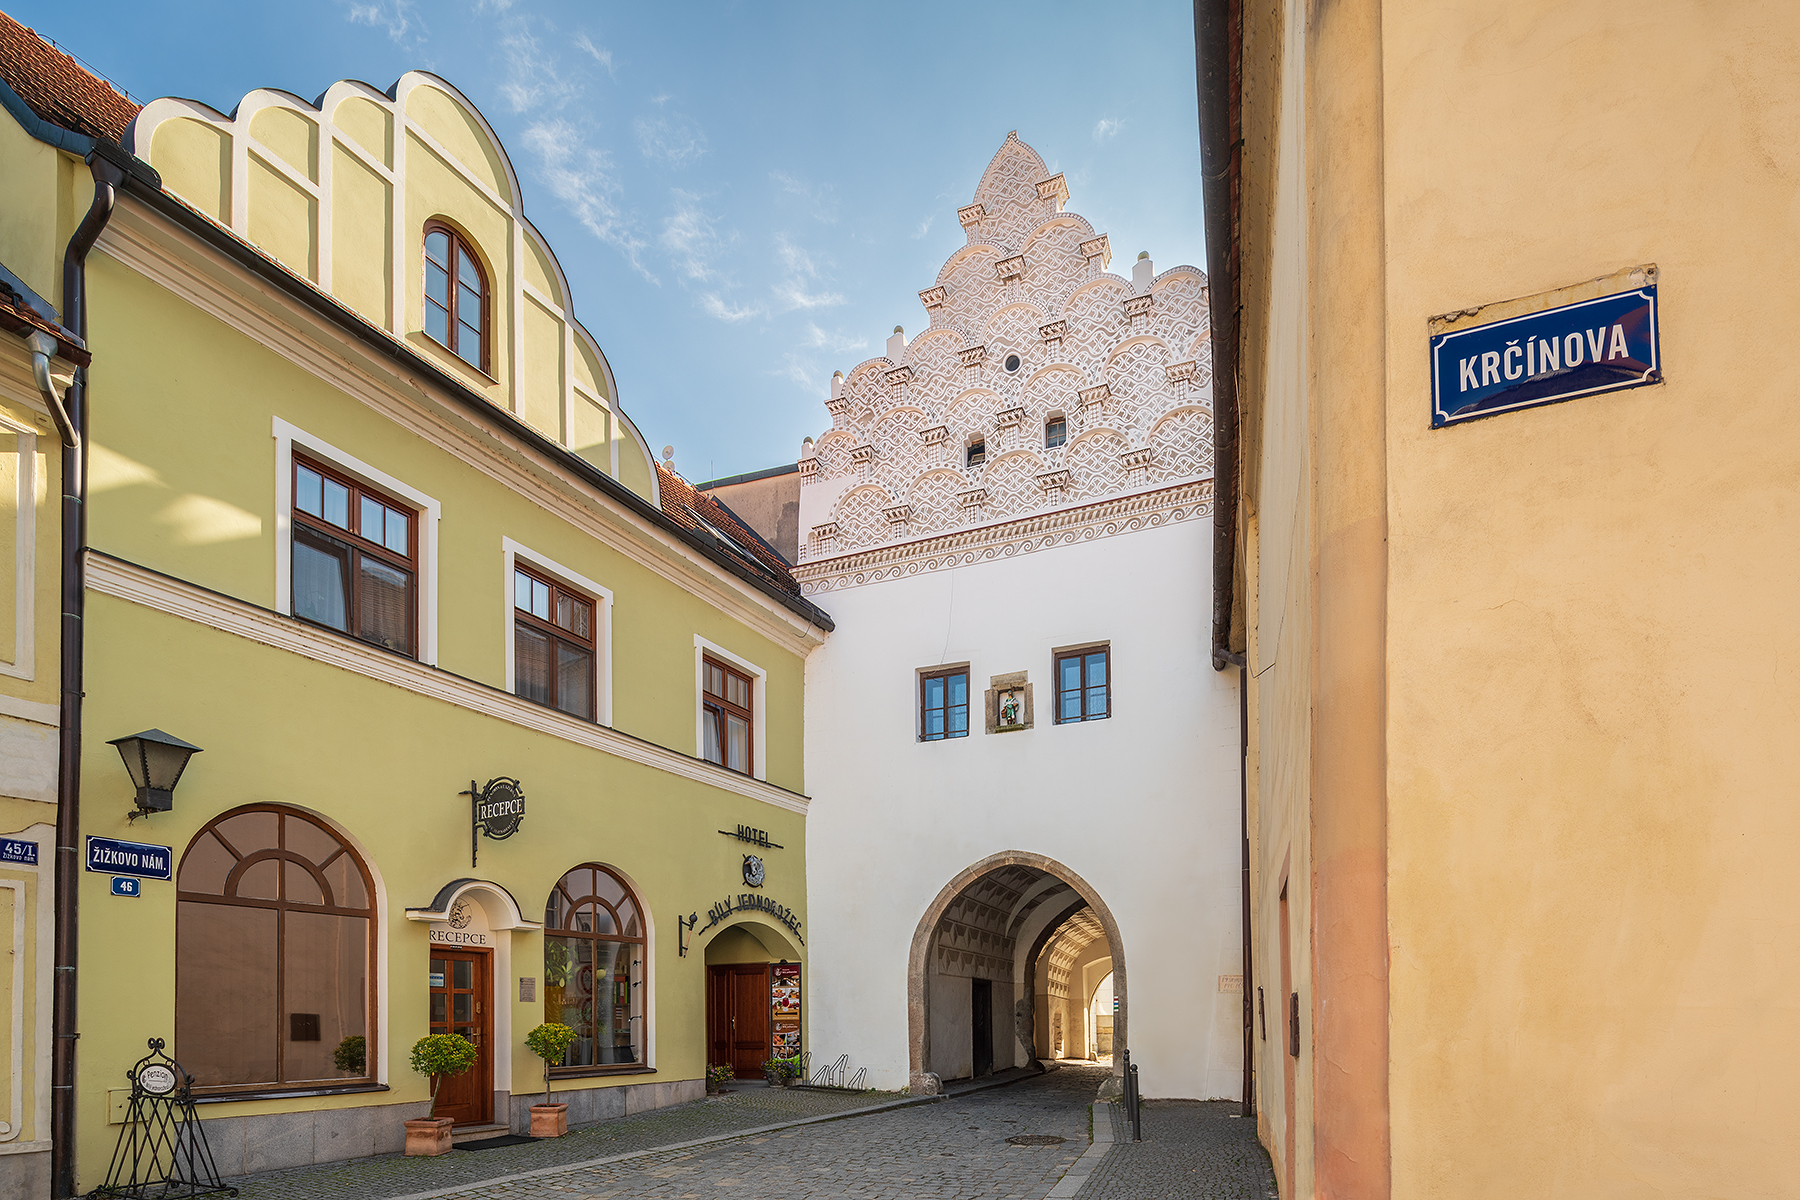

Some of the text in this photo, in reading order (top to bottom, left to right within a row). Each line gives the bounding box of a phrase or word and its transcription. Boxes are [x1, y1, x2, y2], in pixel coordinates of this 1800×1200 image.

[1459, 323, 1629, 393] KRČÍNOVA
[480, 798, 523, 820] RECEPCE
[737, 823, 772, 849] HOTEL
[92, 846, 167, 871] ŽIŽKOVO NÁM.
[120, 881, 133, 892] 46
[707, 892, 802, 936] BÍLÝ JEDNOROŽEC
[429, 929, 487, 945] RECEPCE
